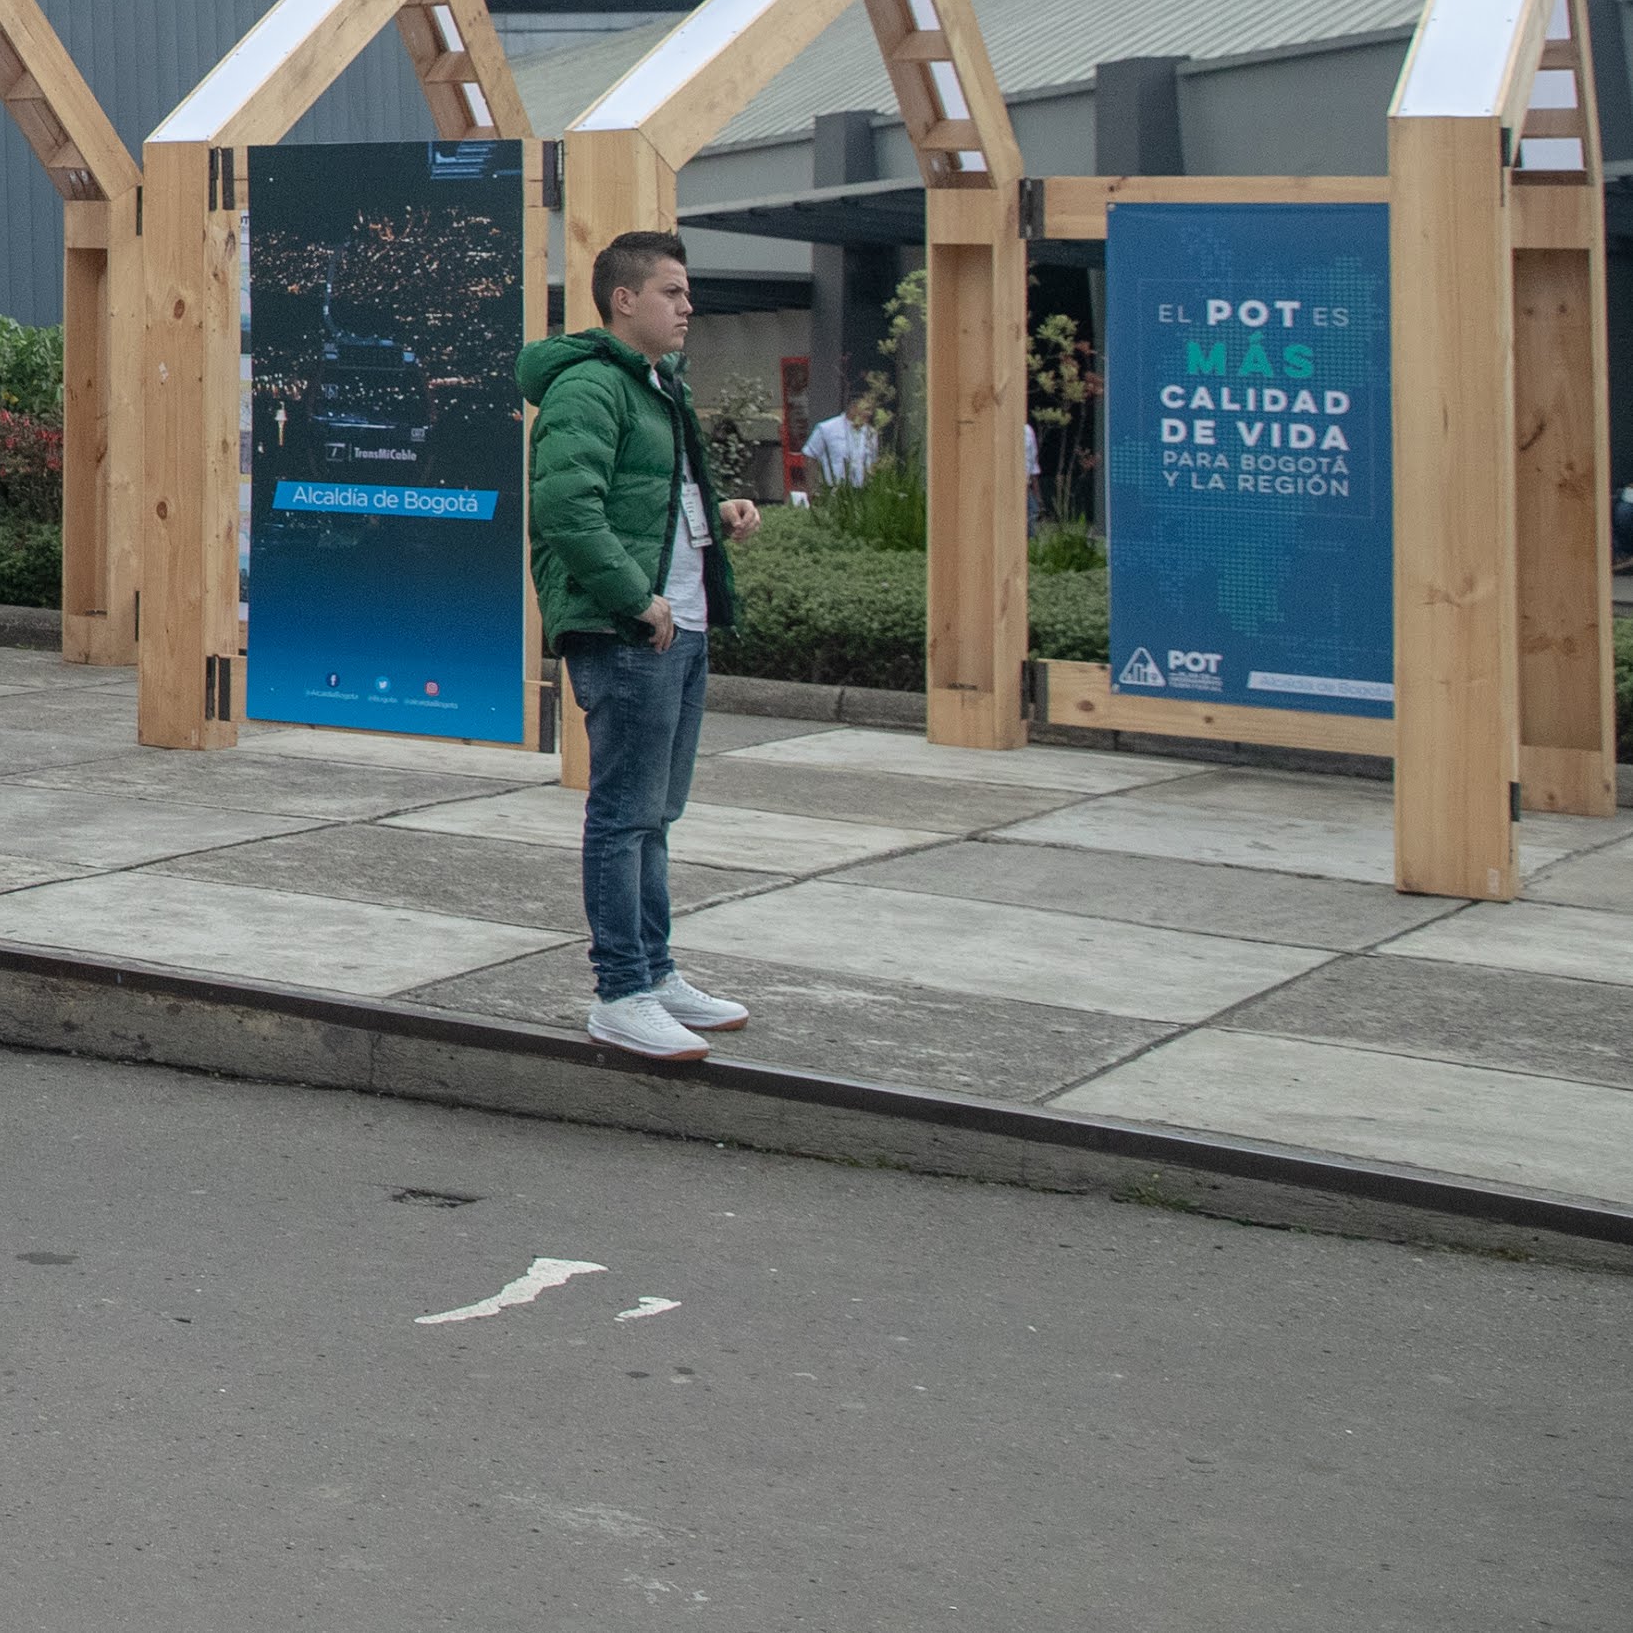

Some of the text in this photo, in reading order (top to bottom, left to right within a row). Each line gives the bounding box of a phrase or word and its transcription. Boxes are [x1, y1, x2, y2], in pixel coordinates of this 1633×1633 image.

[1158, 299, 1350, 328] EL POT ES
[1187, 330, 1314, 379] MÁS
[1160, 384, 1351, 415] CALIDAD
[1161, 418, 1351, 451] DE VIDA
[354, 447, 417, 462] TransMiCable
[1163, 450, 1350, 475] PARA BOGOTÁ
[1162, 470, 1350, 497] Y LA REGIÓN
[292, 485, 478, 514] Alcaldía de Bogotá
[1167, 649, 1223, 673] POT
